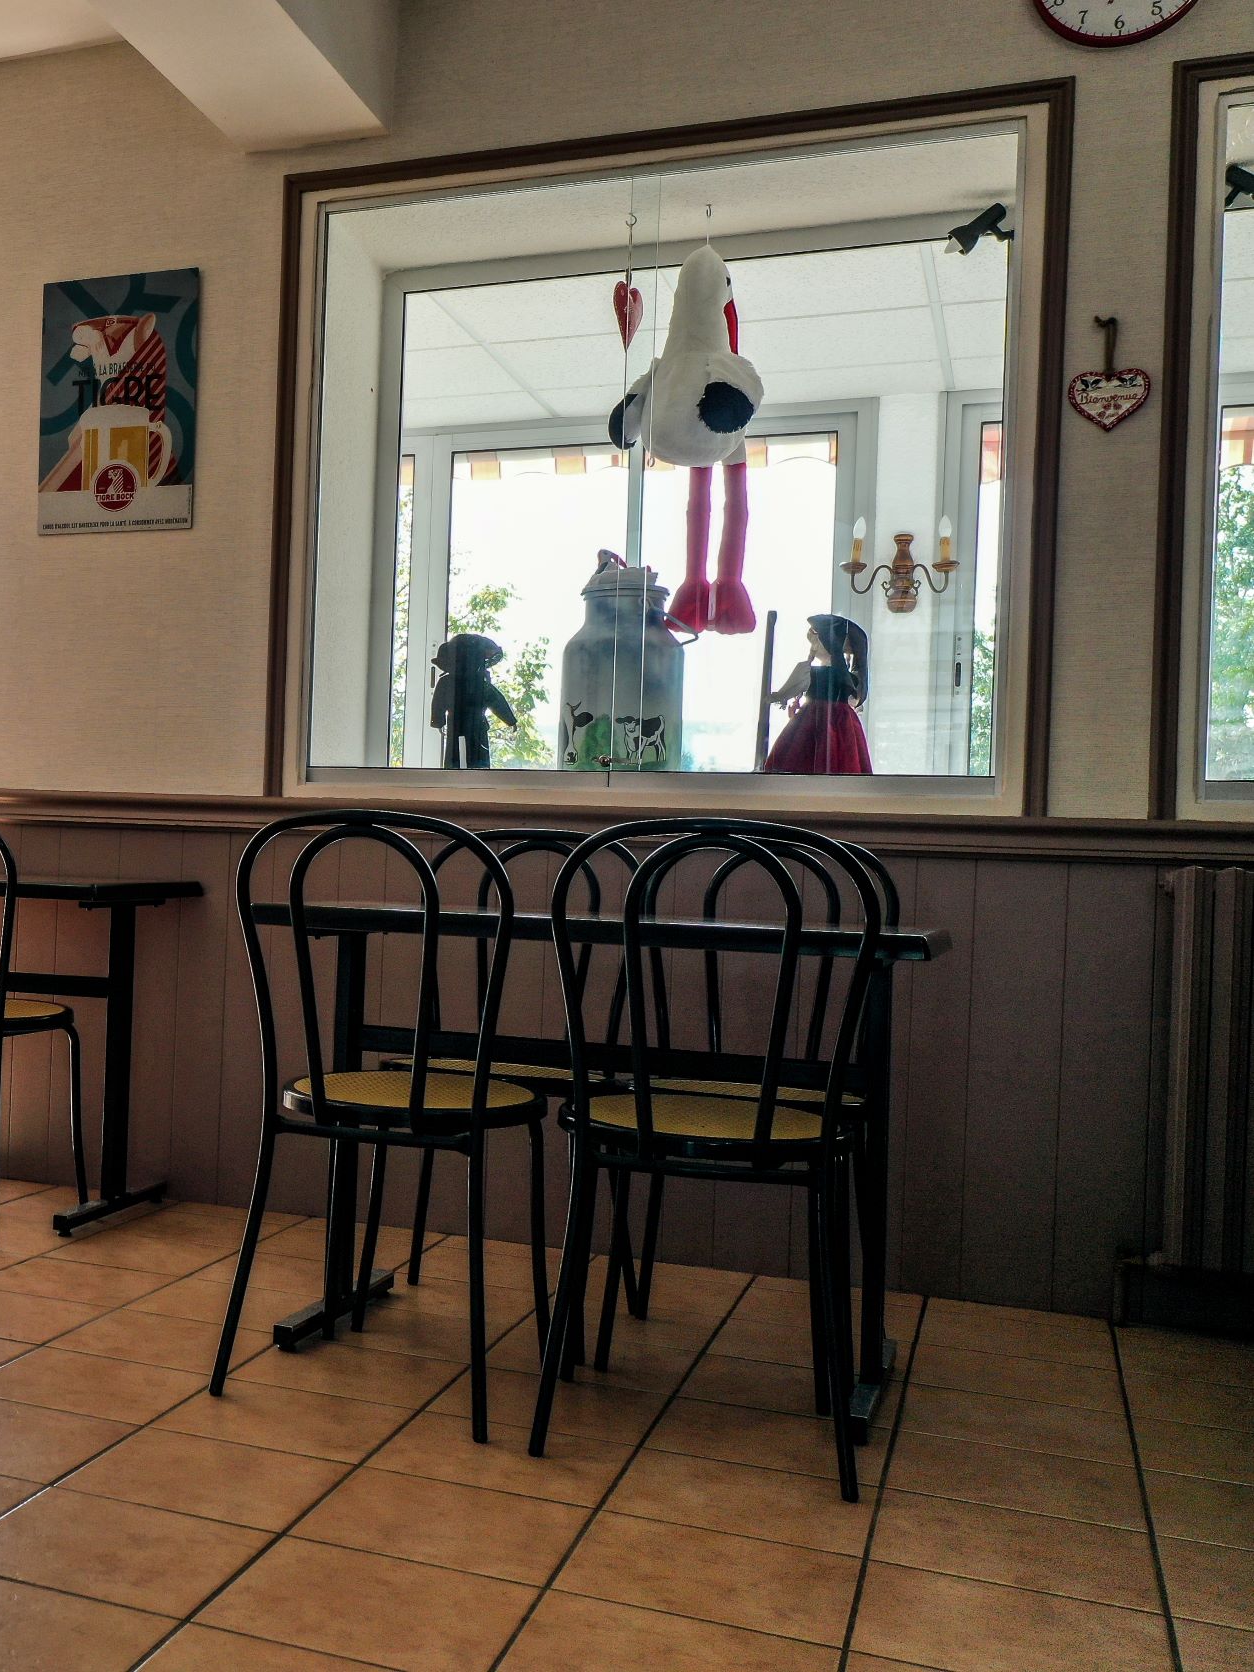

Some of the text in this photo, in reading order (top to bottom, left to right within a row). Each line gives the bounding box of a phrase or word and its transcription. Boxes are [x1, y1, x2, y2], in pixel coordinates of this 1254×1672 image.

[1151, 1, 1162, 15] 5
[1078, 10, 1088, 24] 7
[1114, 15, 1125, 29] 6
[99, 364, 107, 376] LA
[73, 376, 163, 415] TIGRE
[1078, 392, 1141, 404] Bienvenue
